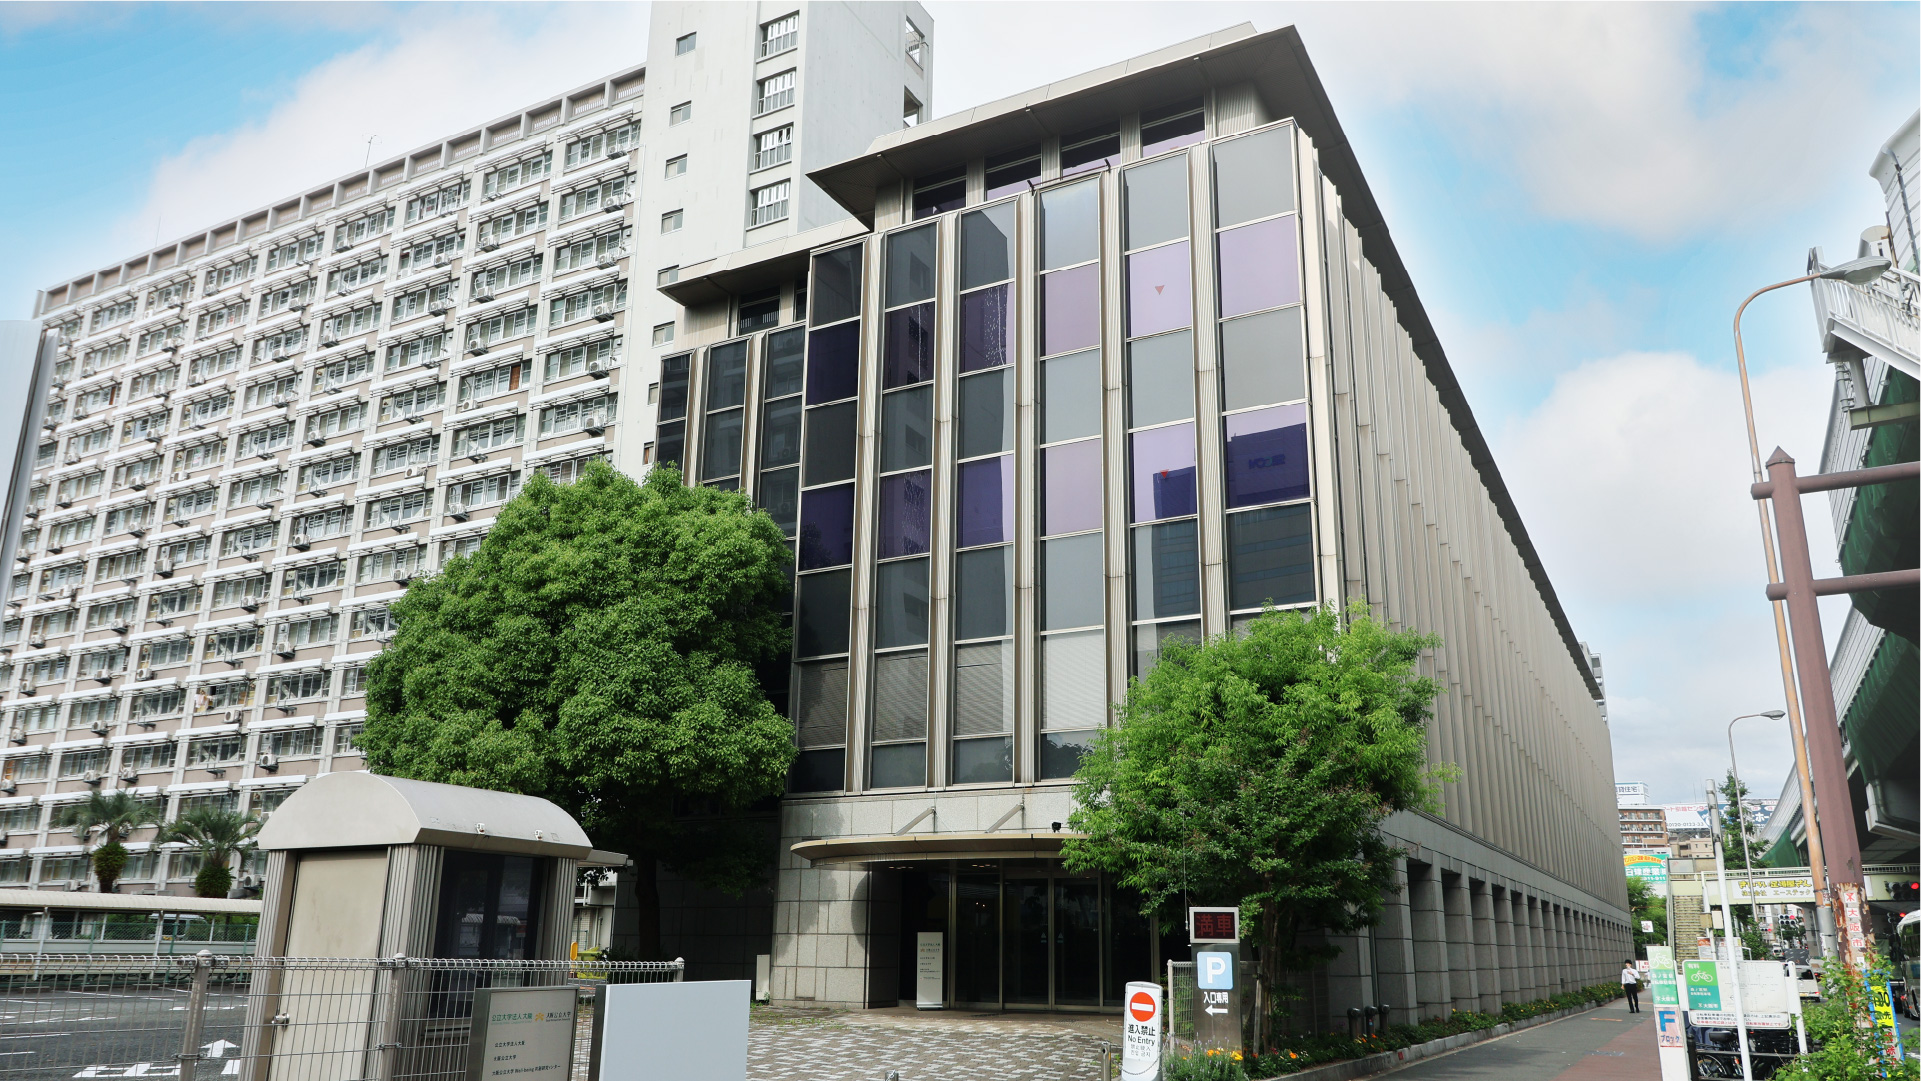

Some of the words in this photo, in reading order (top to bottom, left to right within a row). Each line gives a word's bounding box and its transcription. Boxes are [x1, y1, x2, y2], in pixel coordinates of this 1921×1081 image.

[1196, 914, 1233, 937] 満車
[1848, 908, 1863, 947] 大阪市
[1206, 957, 1226, 984] P
[1203, 991, 1229, 1004] 入口専用
[491, 1012, 533, 1022] 公立大学法人大阪
[1658, 1010, 1676, 1033] F
[1127, 1024, 1156, 1037] 進入禁止
[1127, 1035, 1137, 1043] No
[1137, 1036, 1156, 1047] Entry
[1660, 1034, 1680, 1043] ブロック
